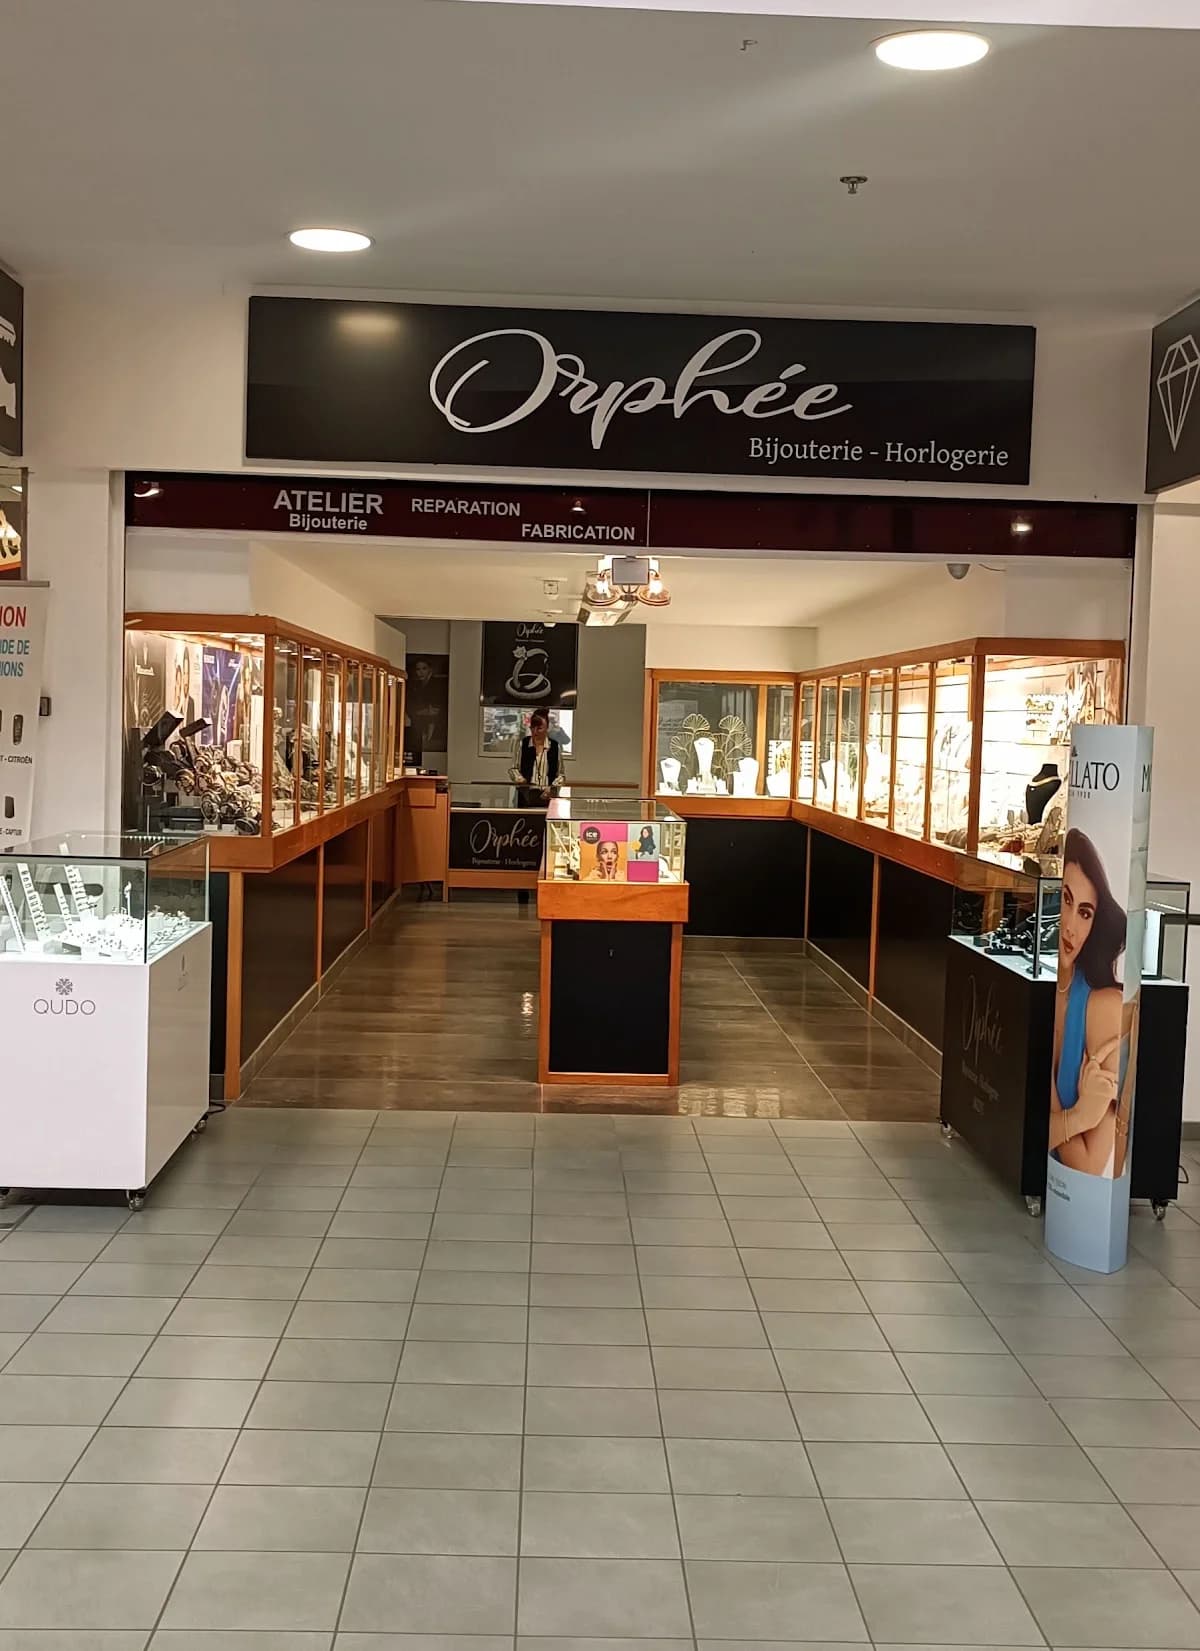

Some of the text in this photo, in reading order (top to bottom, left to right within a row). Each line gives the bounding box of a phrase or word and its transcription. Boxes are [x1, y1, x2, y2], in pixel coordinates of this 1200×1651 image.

[430, 329, 853, 449] Orphée
[749, 437, 863, 464] Bijouterie
[885, 440, 1009, 471] Horlogerie
[273, 489, 384, 515] ATELIER
[411, 498, 521, 517] REPARATION
[289, 513, 368, 531] Bijouterie
[521, 523, 636, 541] FABRICATION
[17, 639, 30, 655] DE
[470, 818, 540, 858] Orphée
[33, 999, 96, 1016] QUDO
